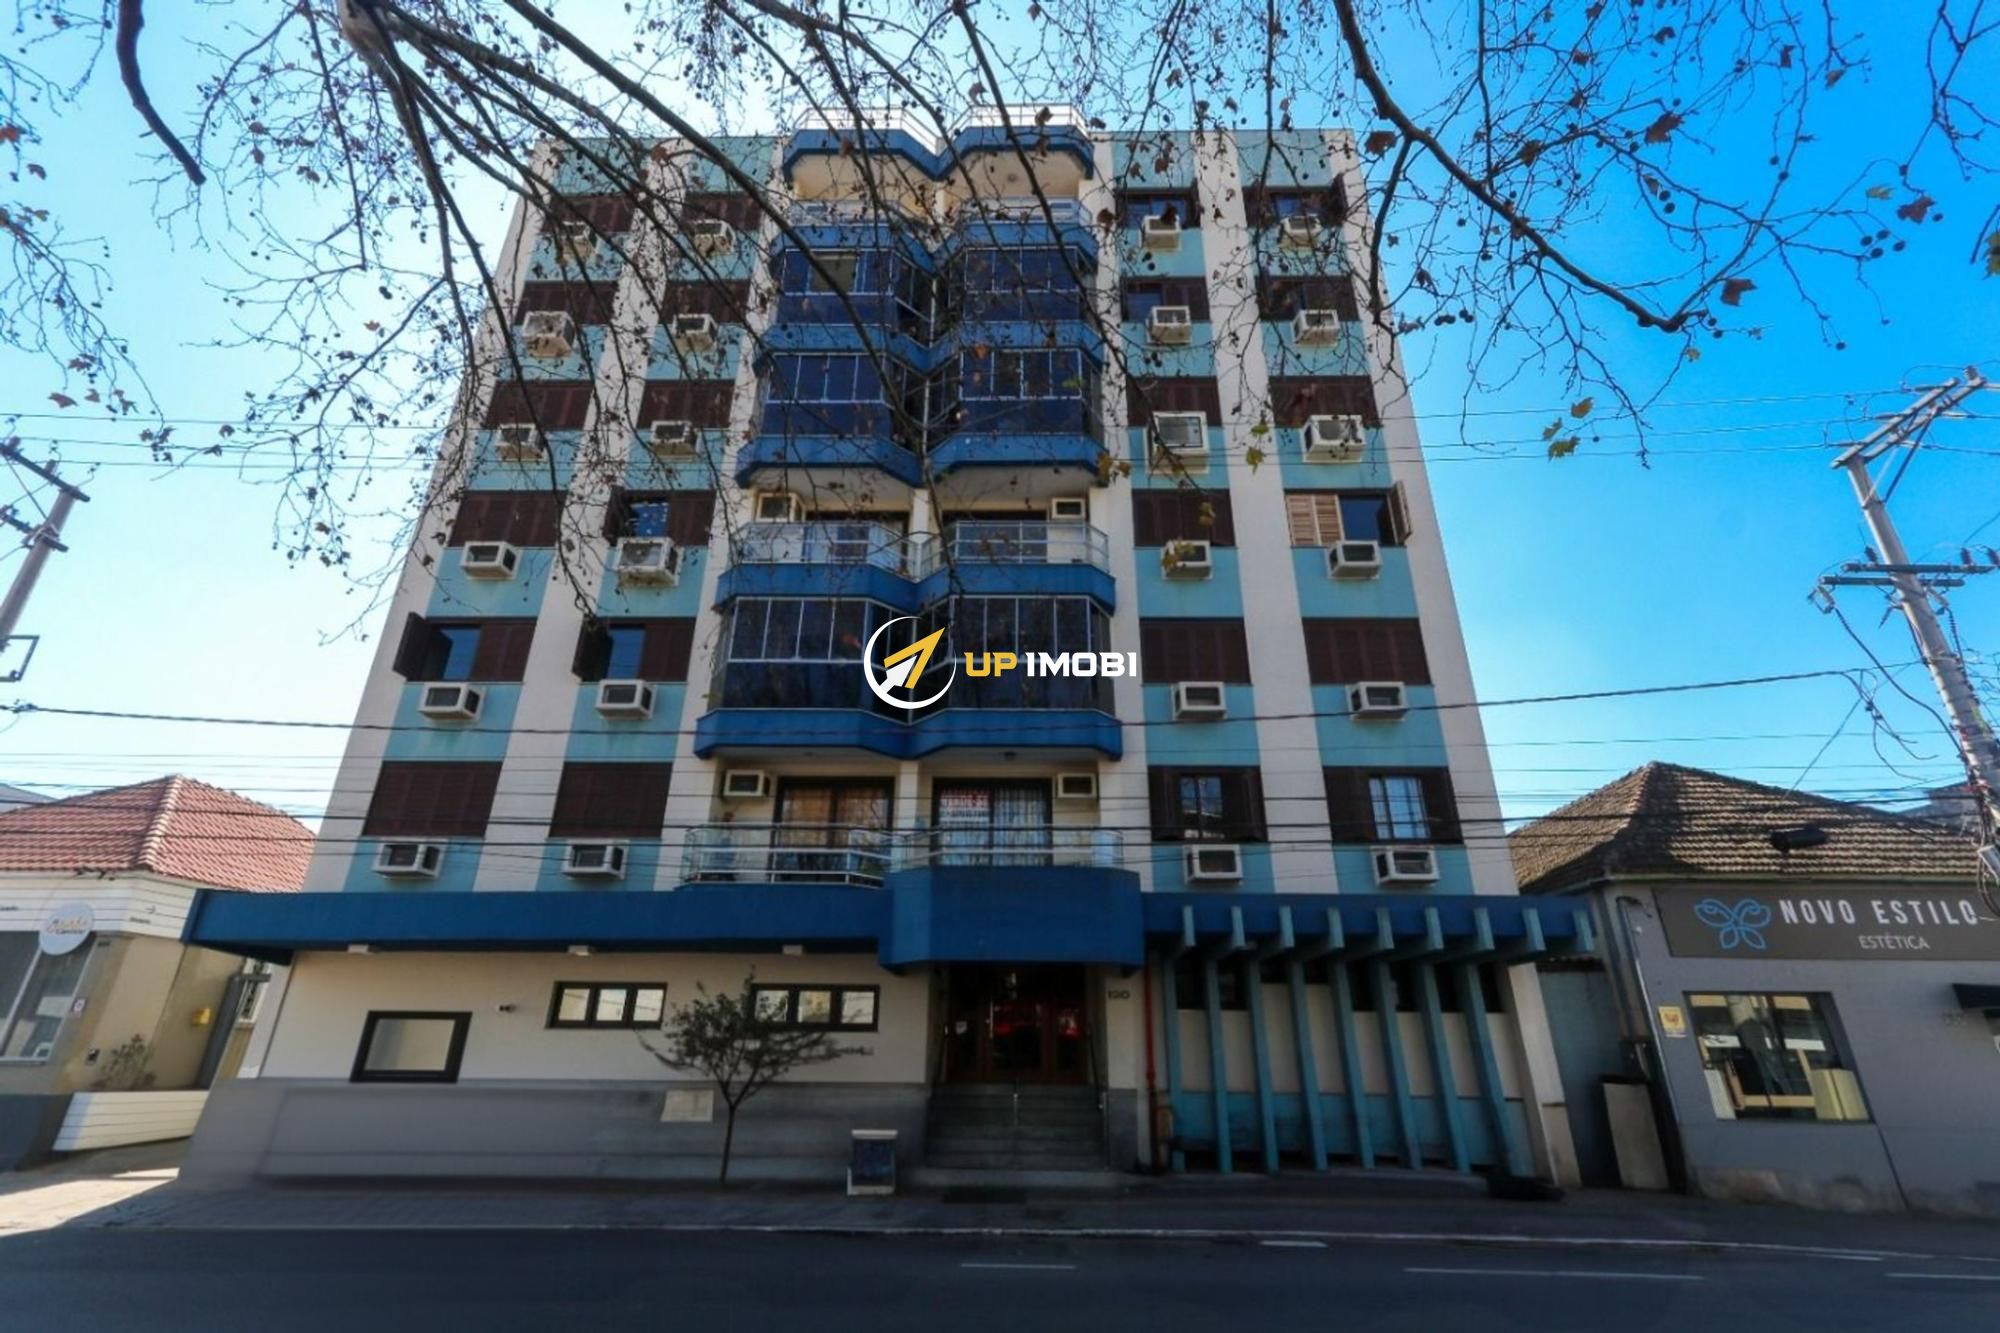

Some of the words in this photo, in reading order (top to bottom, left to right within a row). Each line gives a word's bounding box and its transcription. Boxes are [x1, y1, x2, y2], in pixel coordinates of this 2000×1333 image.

[1778, 899, 1856, 925] NOVO
[1870, 899, 1979, 925] ESTILO
[1858, 931, 1930, 950] ESTÉTICA
